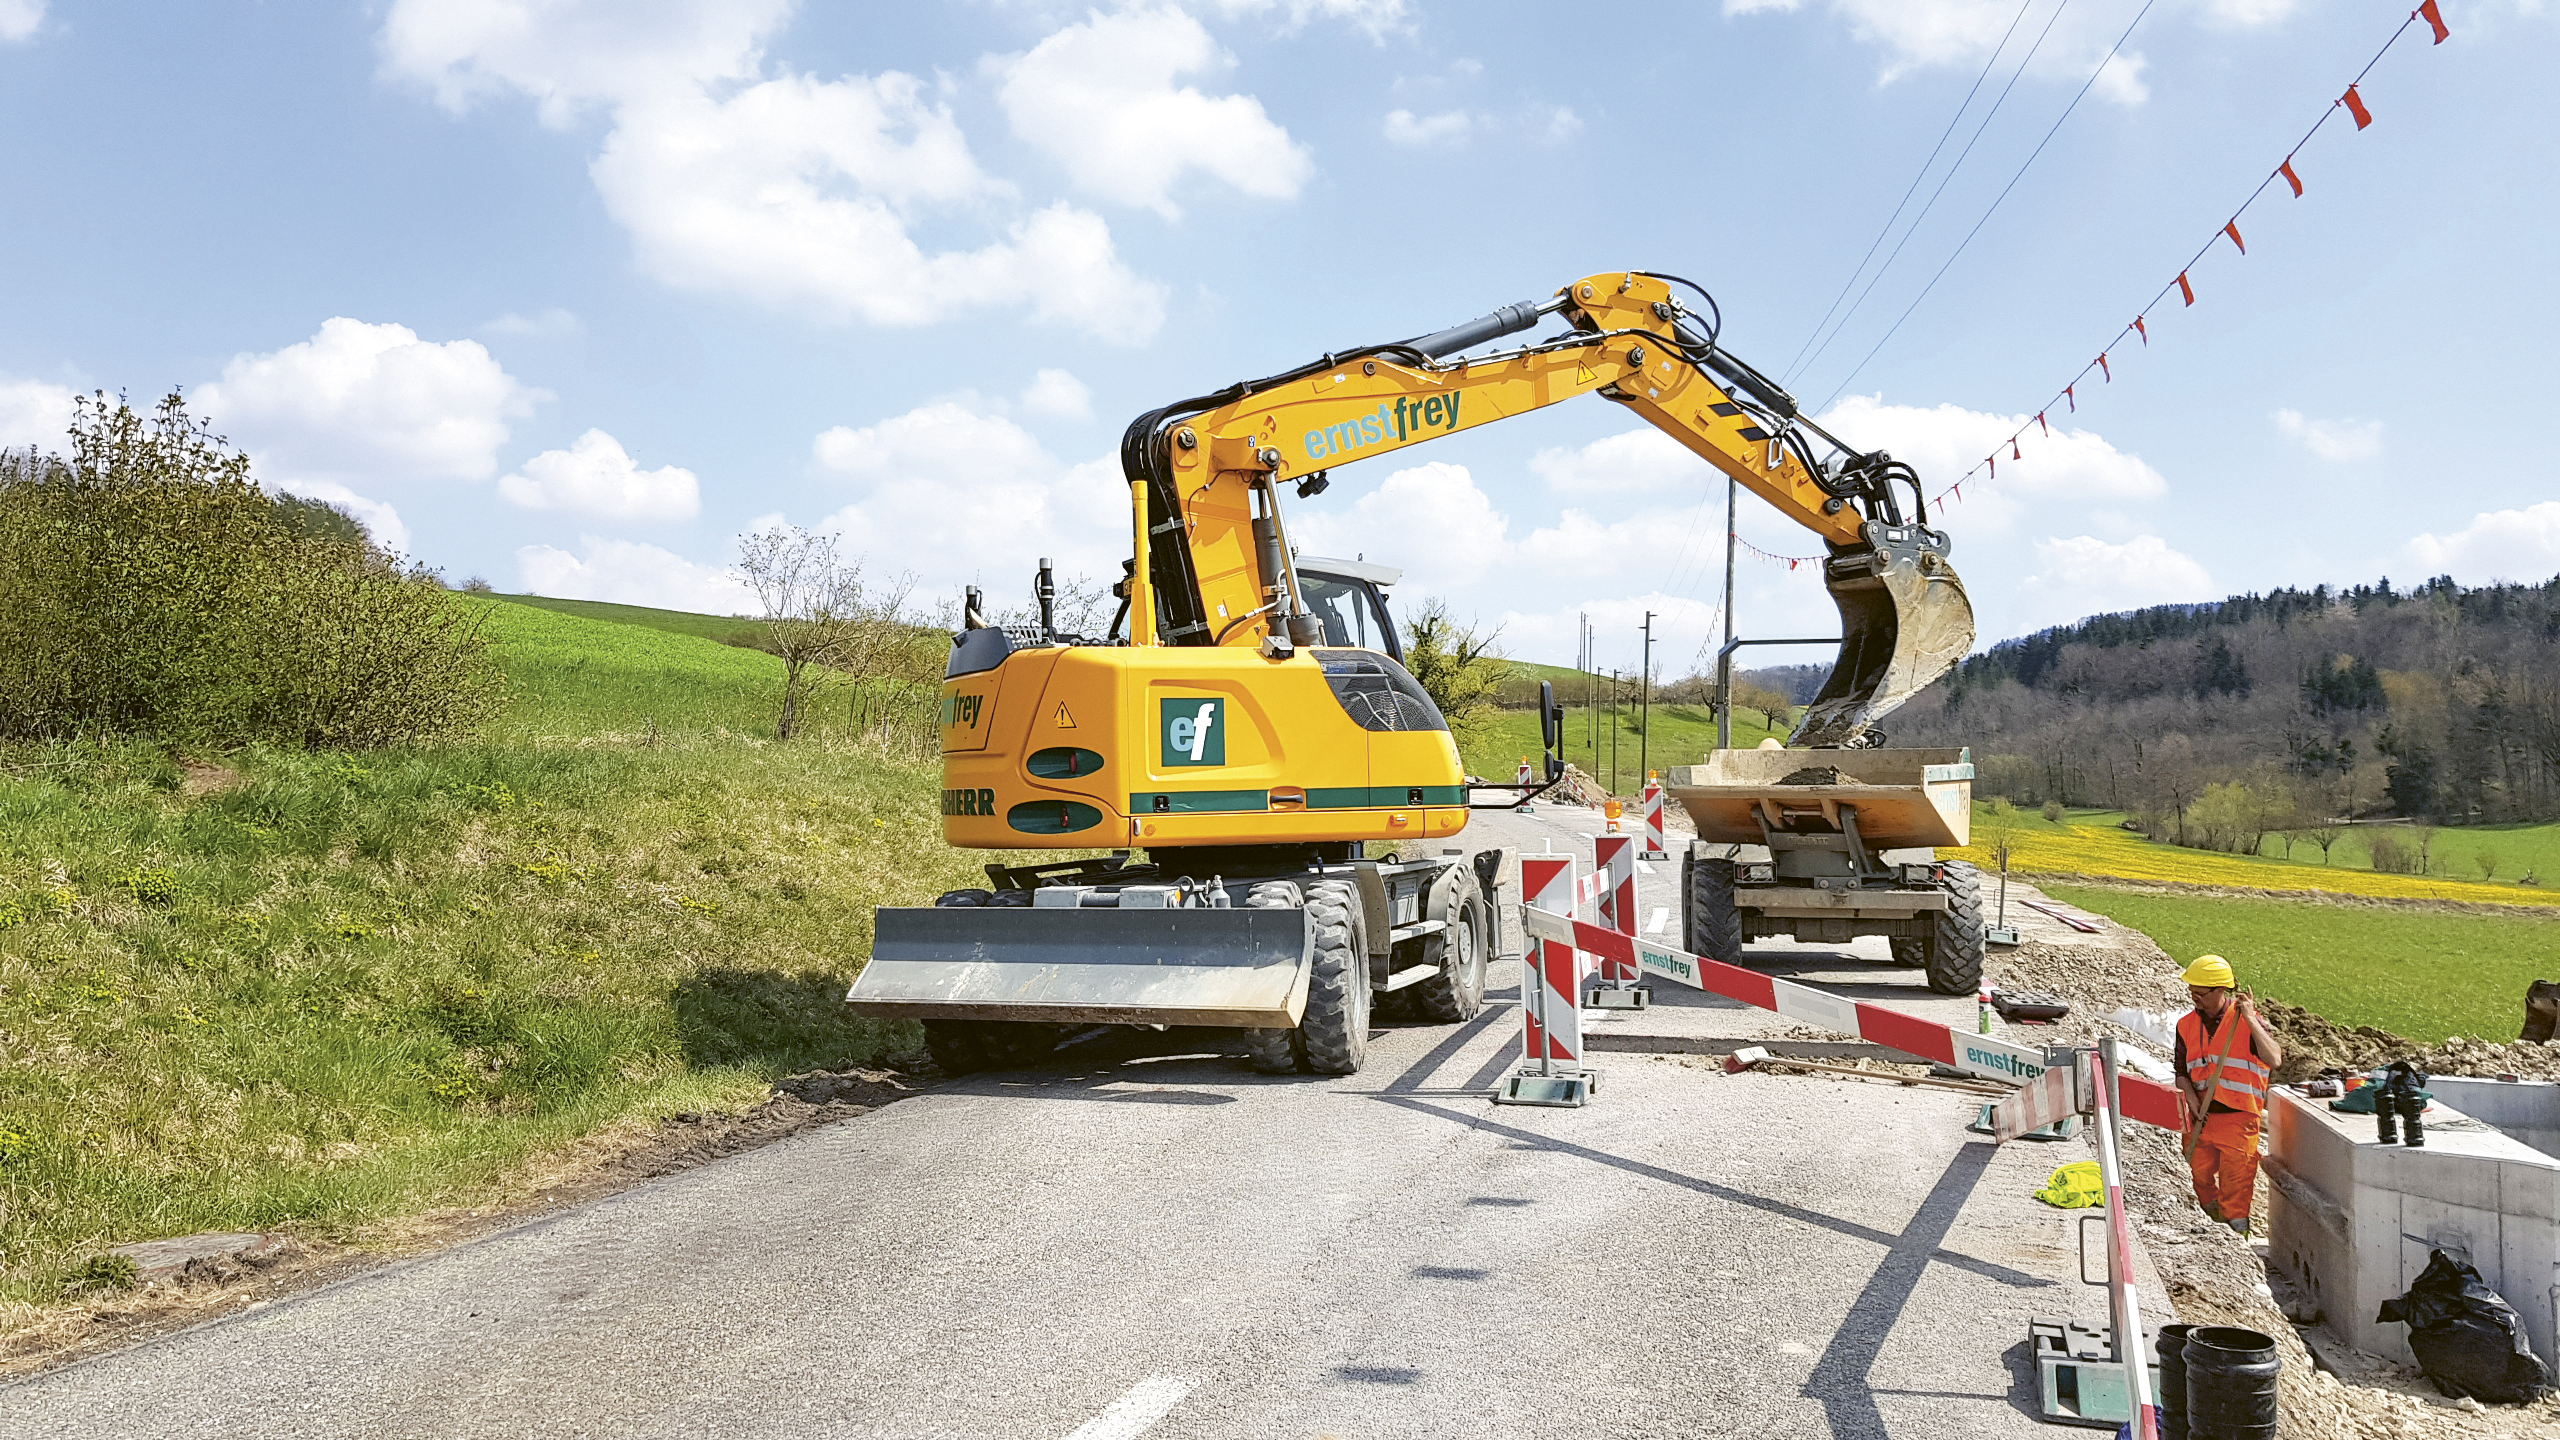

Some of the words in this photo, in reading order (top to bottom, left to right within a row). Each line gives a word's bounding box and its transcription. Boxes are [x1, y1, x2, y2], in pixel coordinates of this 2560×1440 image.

[1304, 391, 1460, 459] ernstfrey
[1170, 703, 1215, 761] ef
[1642, 950, 1691, 979] ernstfrey
